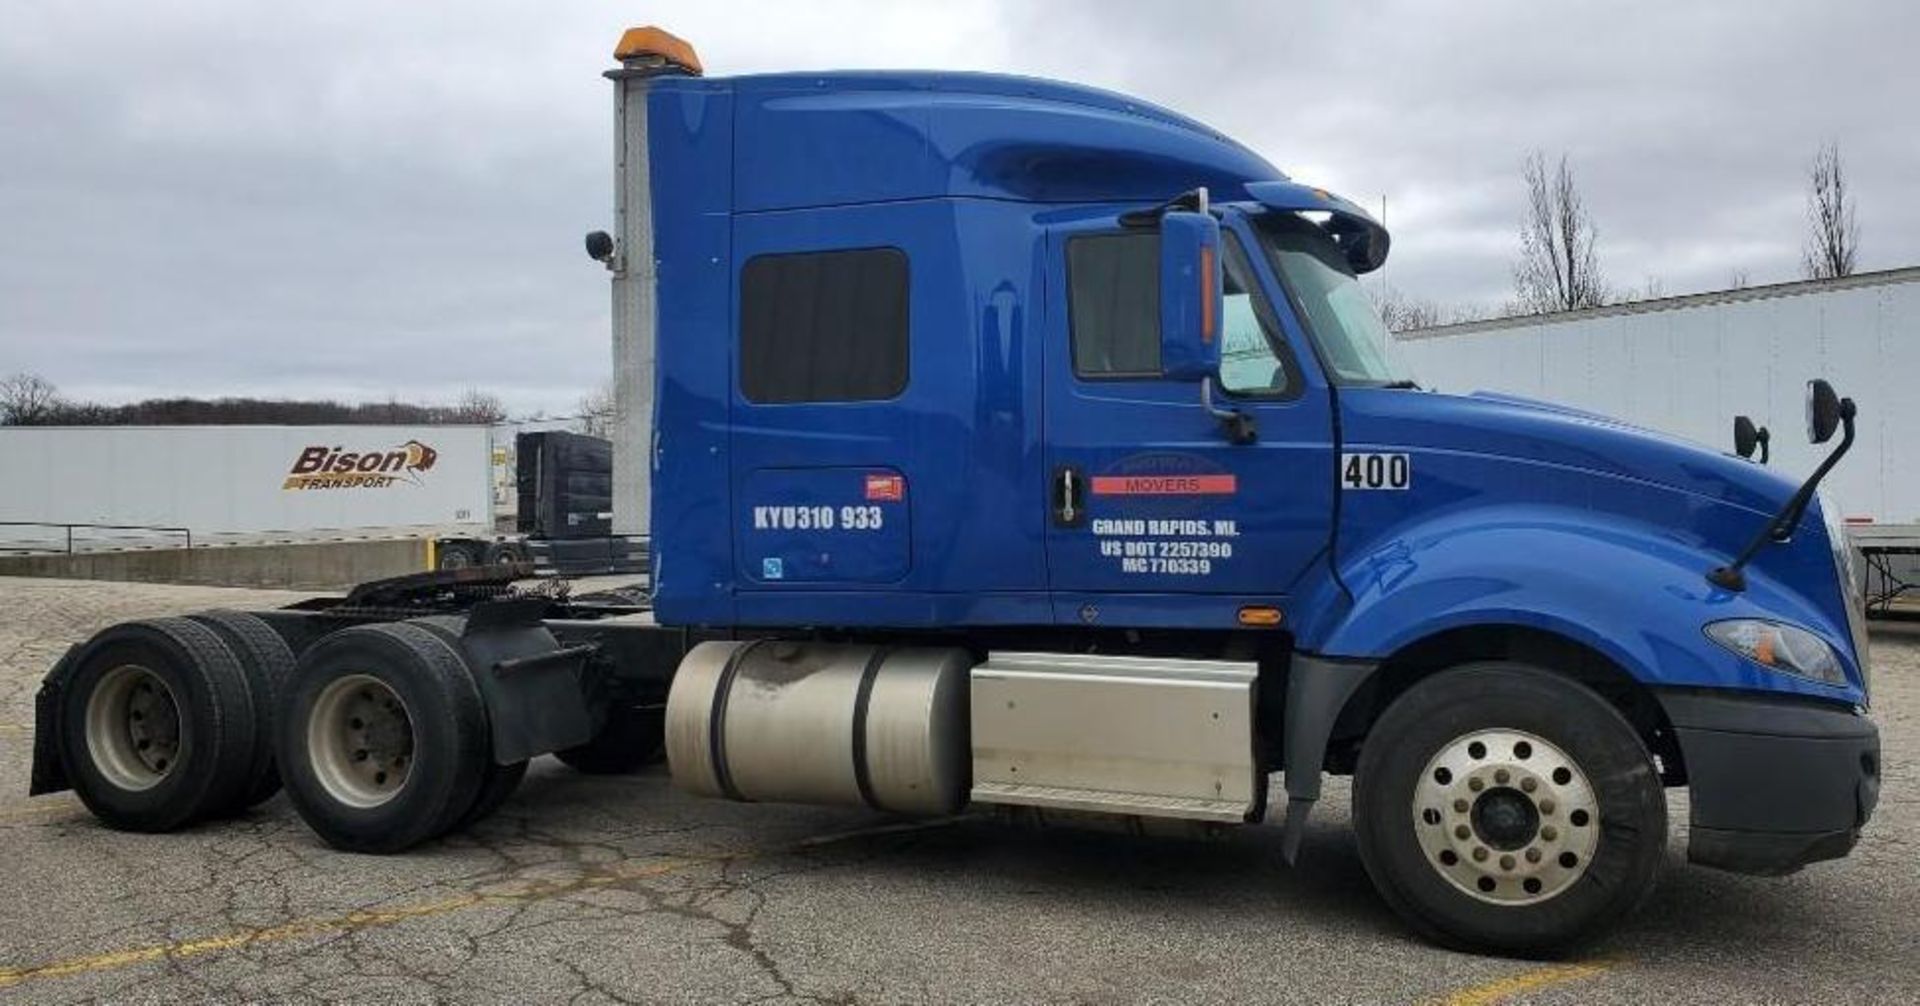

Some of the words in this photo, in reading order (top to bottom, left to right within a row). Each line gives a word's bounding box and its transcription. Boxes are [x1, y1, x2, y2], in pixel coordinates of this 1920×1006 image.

[291, 446, 407, 474] Bison
[1345, 455, 1407, 488] 400
[299, 477, 396, 490] TRANSPORT
[1126, 478, 1200, 493] MOVERS
[754, 506, 834, 529] KYU310
[841, 506, 883, 529] 933
[1092, 519, 1145, 535] GRAND
[1101, 541, 1122, 556] US
[1125, 542, 1157, 557] DOT
[1160, 542, 1232, 558] 2257390
[1122, 558, 1147, 572] MC
[1149, 558, 1211, 574] 770339
